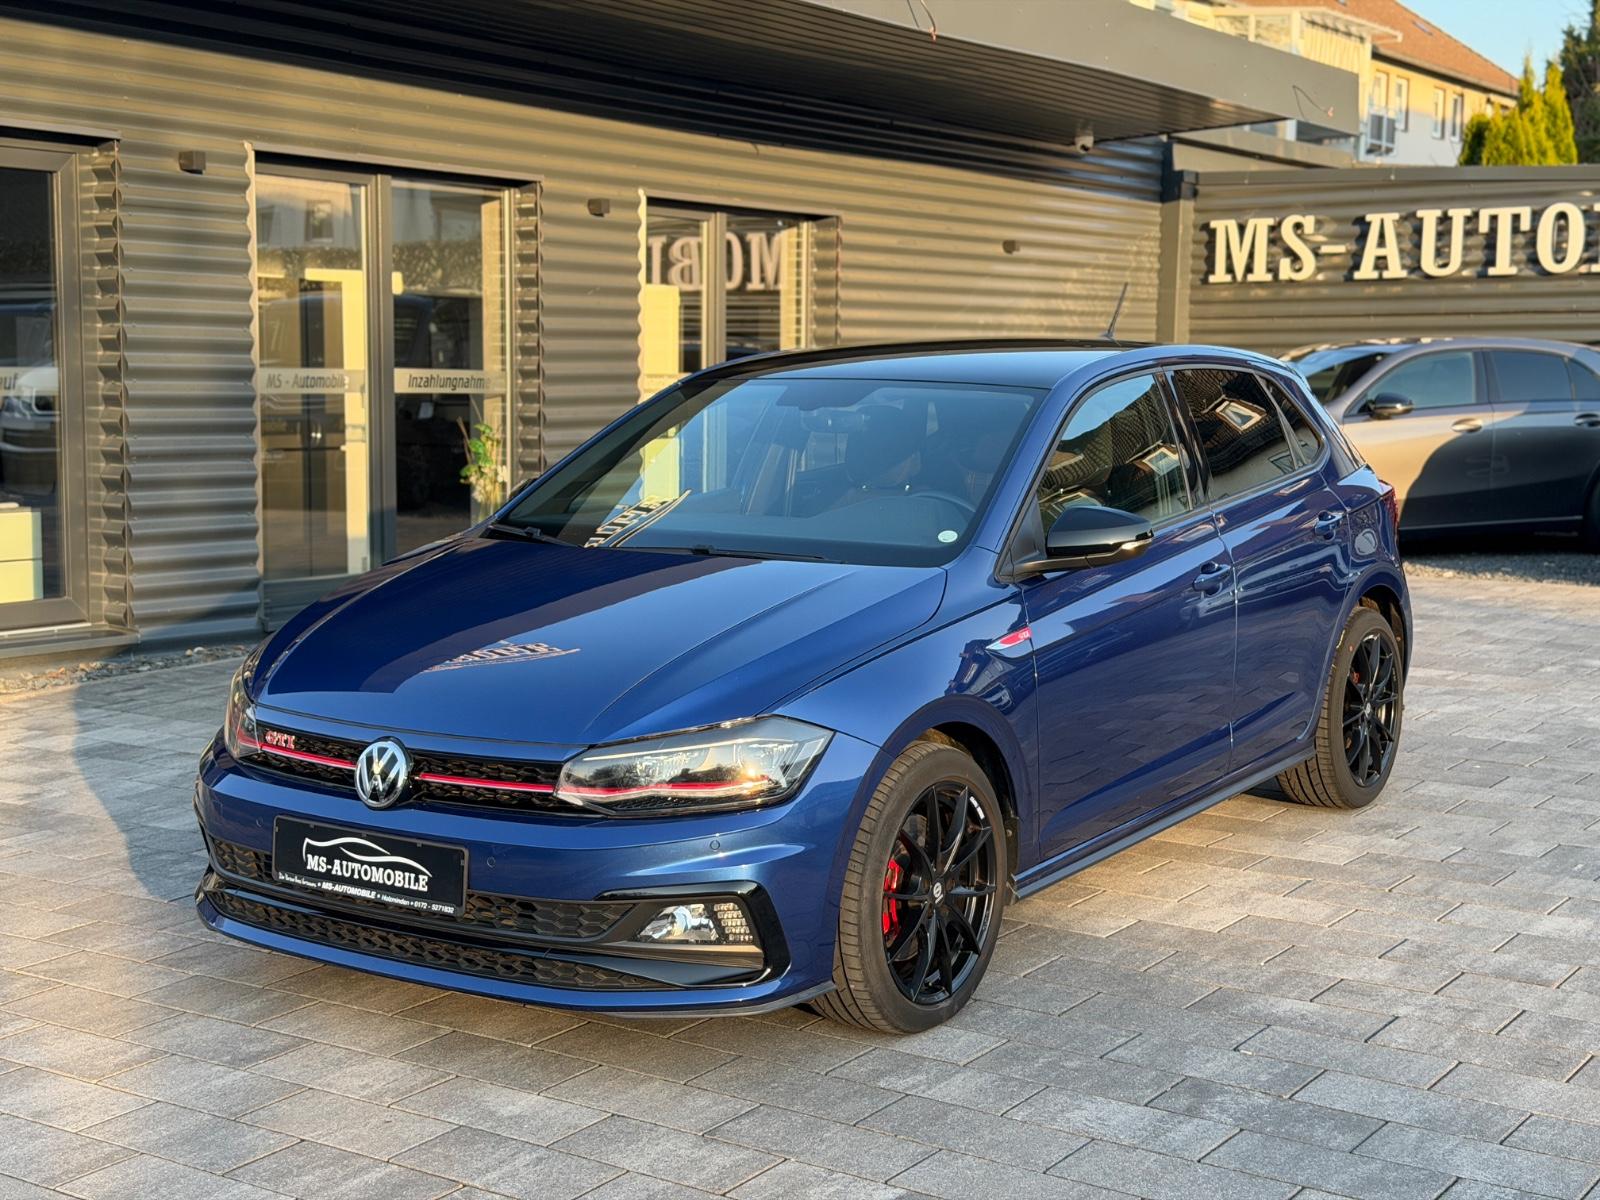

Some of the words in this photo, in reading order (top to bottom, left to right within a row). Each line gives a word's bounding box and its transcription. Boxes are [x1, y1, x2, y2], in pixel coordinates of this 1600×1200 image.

[1208, 202, 1600, 284] MS-AUTO
[266, 373, 282, 388] MS
[265, 730, 296, 750] GTI
[306, 853, 428, 892] MS-AUTOMOBILE
[321, 881, 376, 899] MS-AUTOMOBILE
